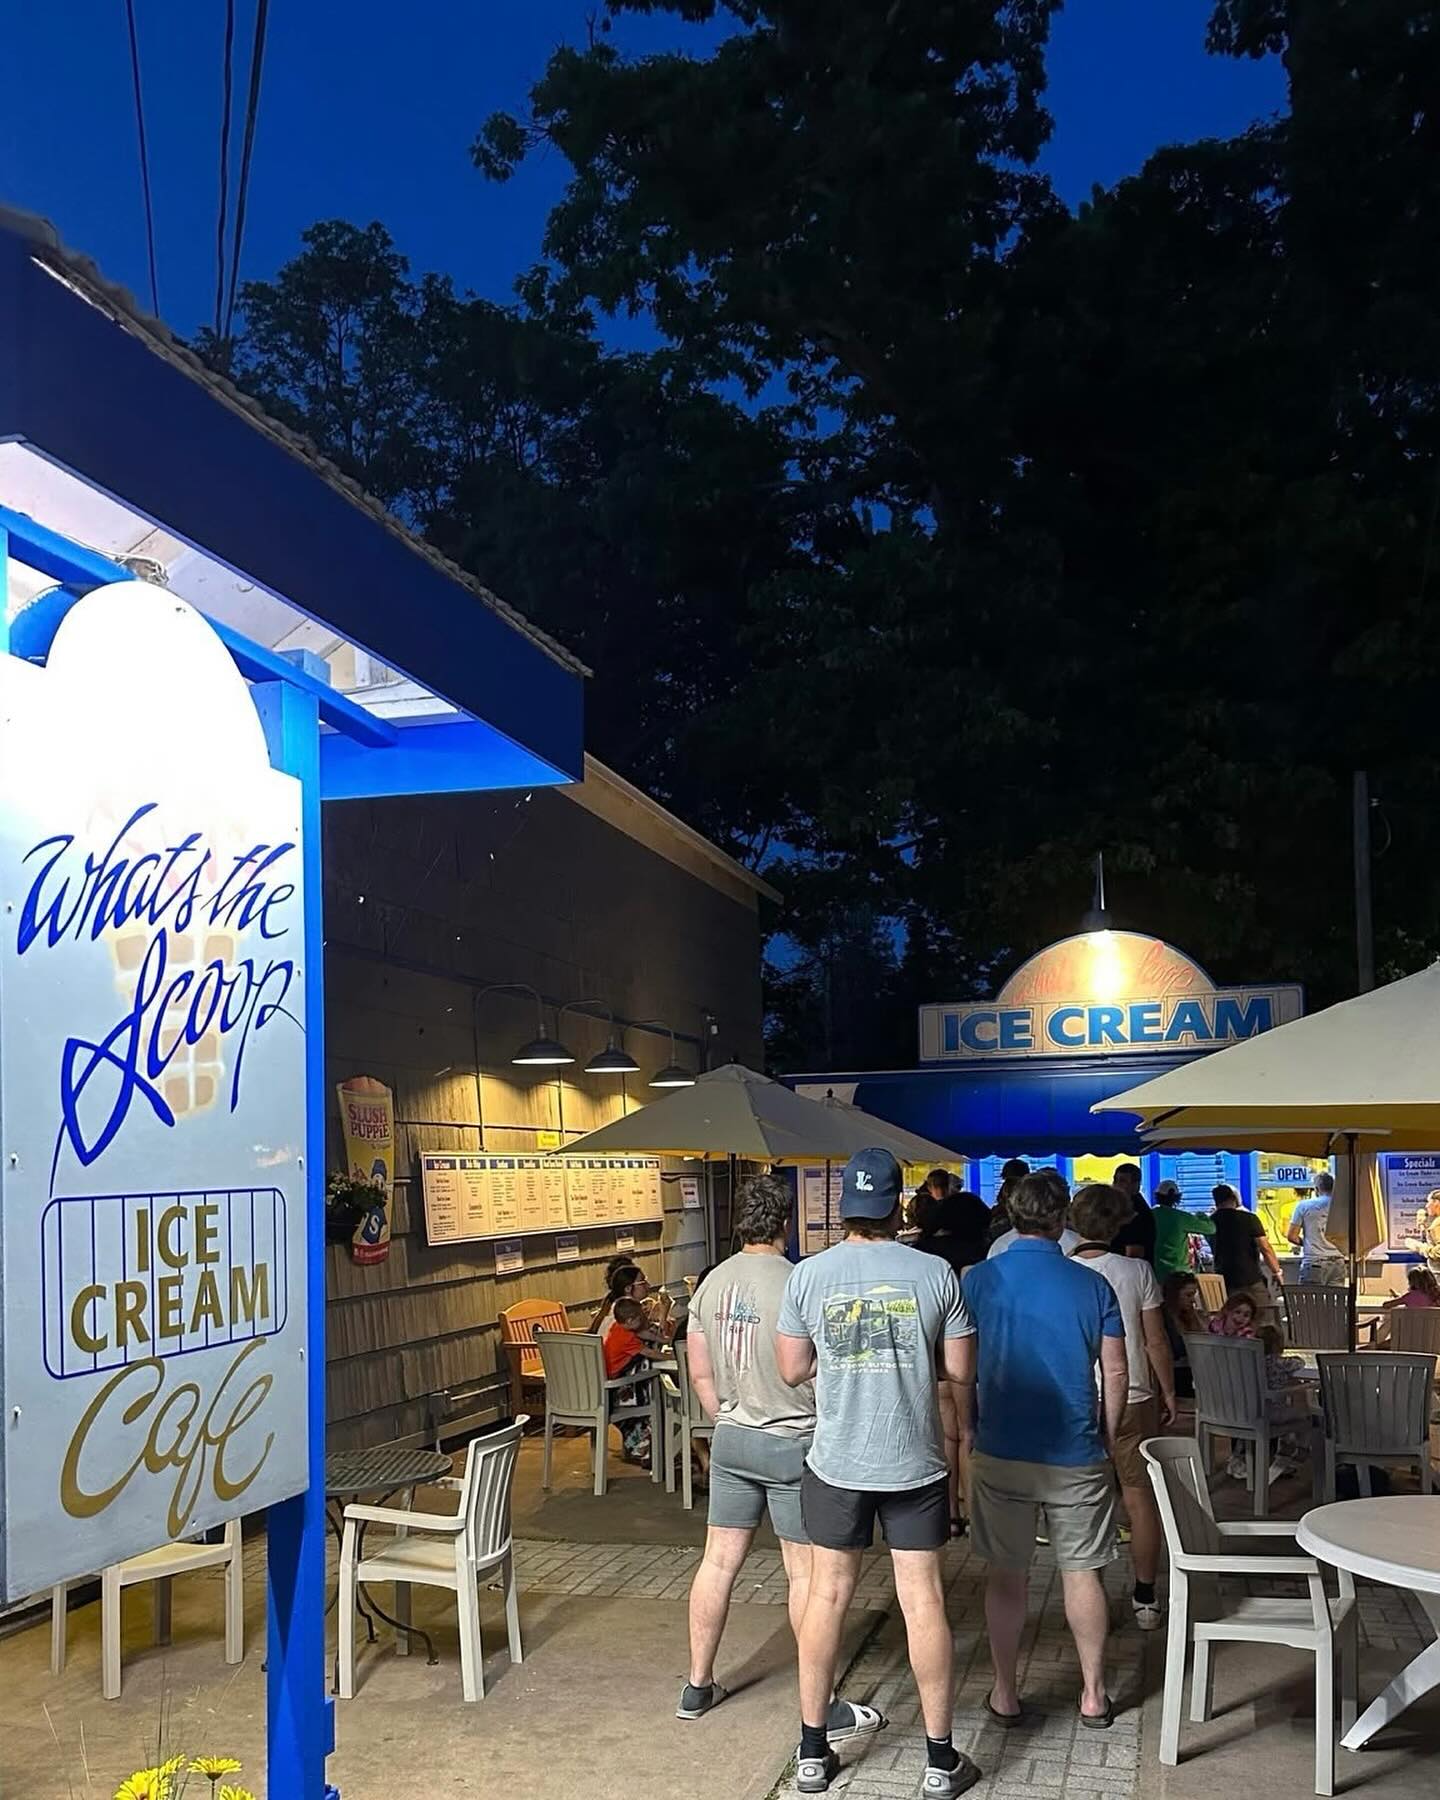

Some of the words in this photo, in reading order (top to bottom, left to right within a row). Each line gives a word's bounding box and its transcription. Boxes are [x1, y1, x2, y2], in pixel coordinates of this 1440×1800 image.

[200, 842, 296, 939] the
[943, 1011, 1035, 1053] ICE
[1047, 997, 1273, 1048] CREAM
[50, 928, 306, 1198] Scoop
[348, 1103, 387, 1123] SLUSH
[1277, 1167, 1307, 1181] OPEN
[1404, 1157, 1436, 1169] Specials
[136, 1204, 220, 1272] ICE
[70, 1263, 270, 1354] CREAM
